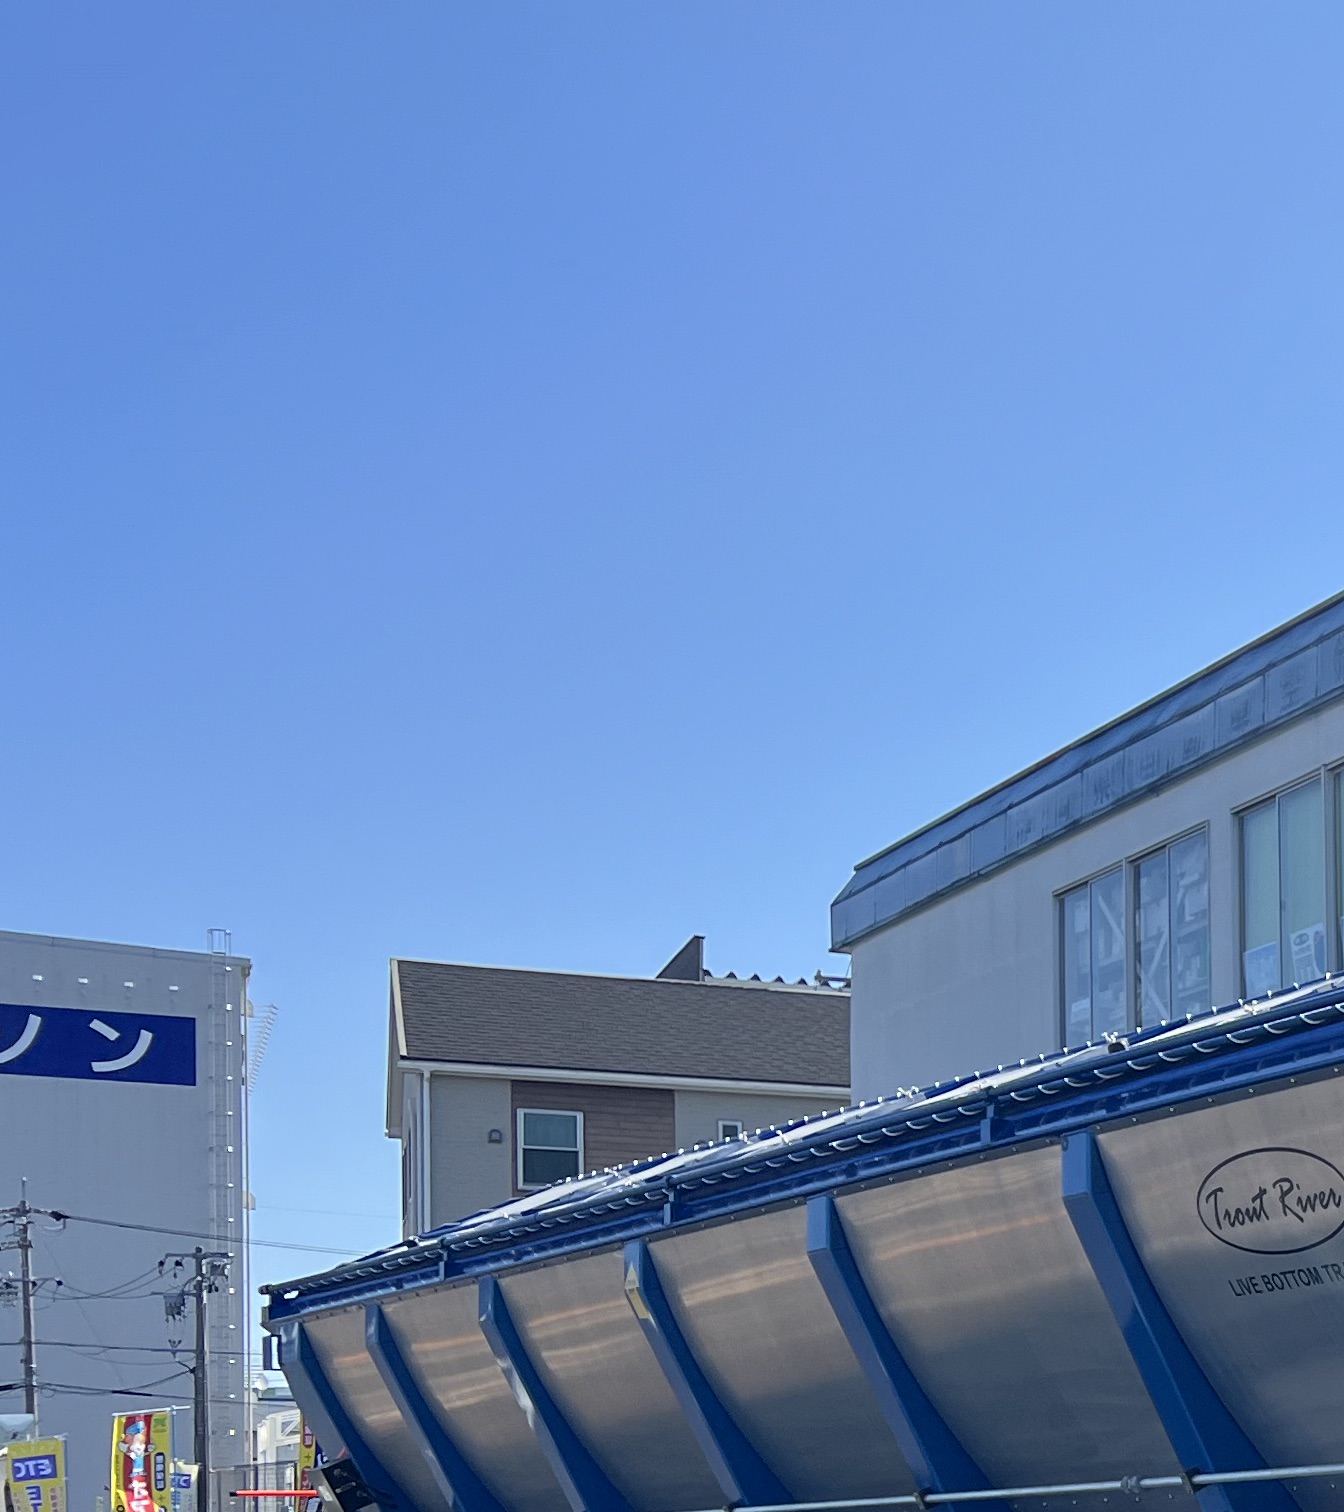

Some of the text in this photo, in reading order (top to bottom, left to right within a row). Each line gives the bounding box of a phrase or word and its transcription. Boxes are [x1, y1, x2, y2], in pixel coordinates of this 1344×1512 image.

[1205, 1177, 1342, 1230] Trout River
[1228, 1272, 1263, 1297] LIVE
[1263, 1266, 1323, 1293] BOTTOM
